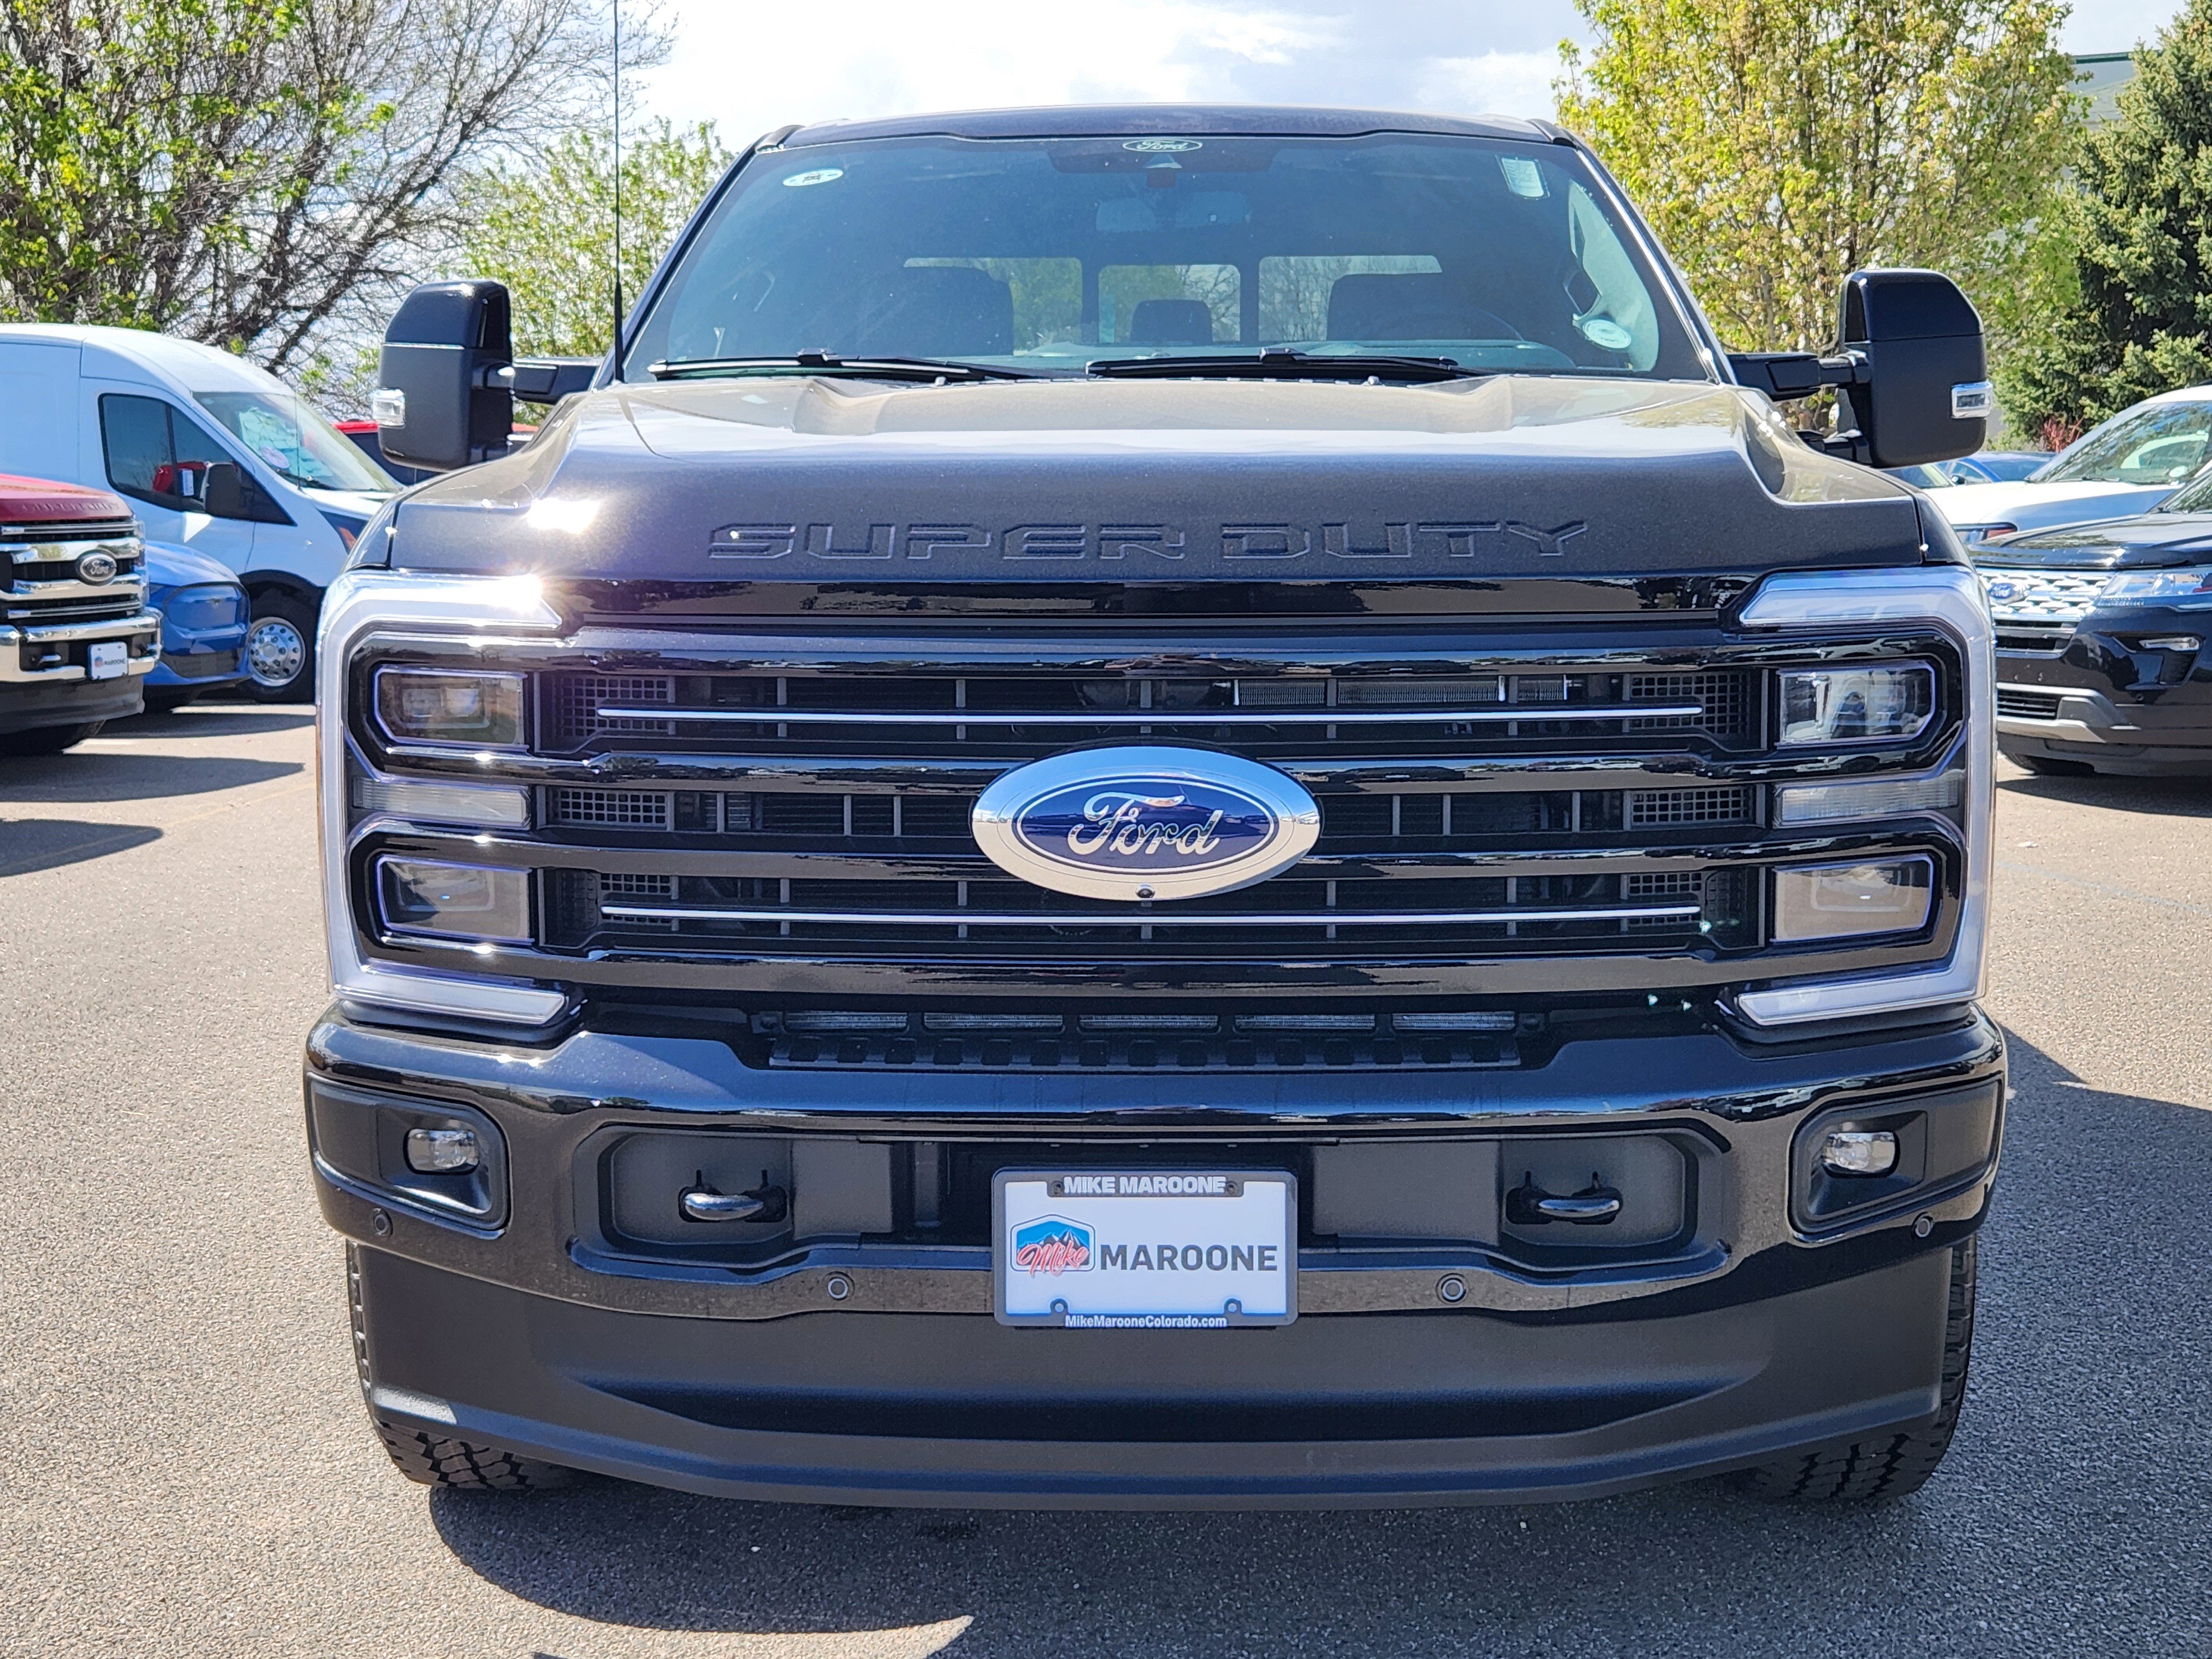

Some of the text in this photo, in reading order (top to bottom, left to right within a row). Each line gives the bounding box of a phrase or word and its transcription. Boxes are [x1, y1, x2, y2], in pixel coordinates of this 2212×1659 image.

[1136, 140, 1188, 150] Ford
[709, 520, 1587, 560] SUPER DUTY
[1067, 792, 1224, 855] Ford
[1063, 1176, 1227, 1193] MIKE MAROONE
[1016, 1240, 1091, 1277] Mike
[1100, 1244, 1277, 1271] MAROONE
[1065, 1315, 1227, 1327] MikeMarooneColorado.com
